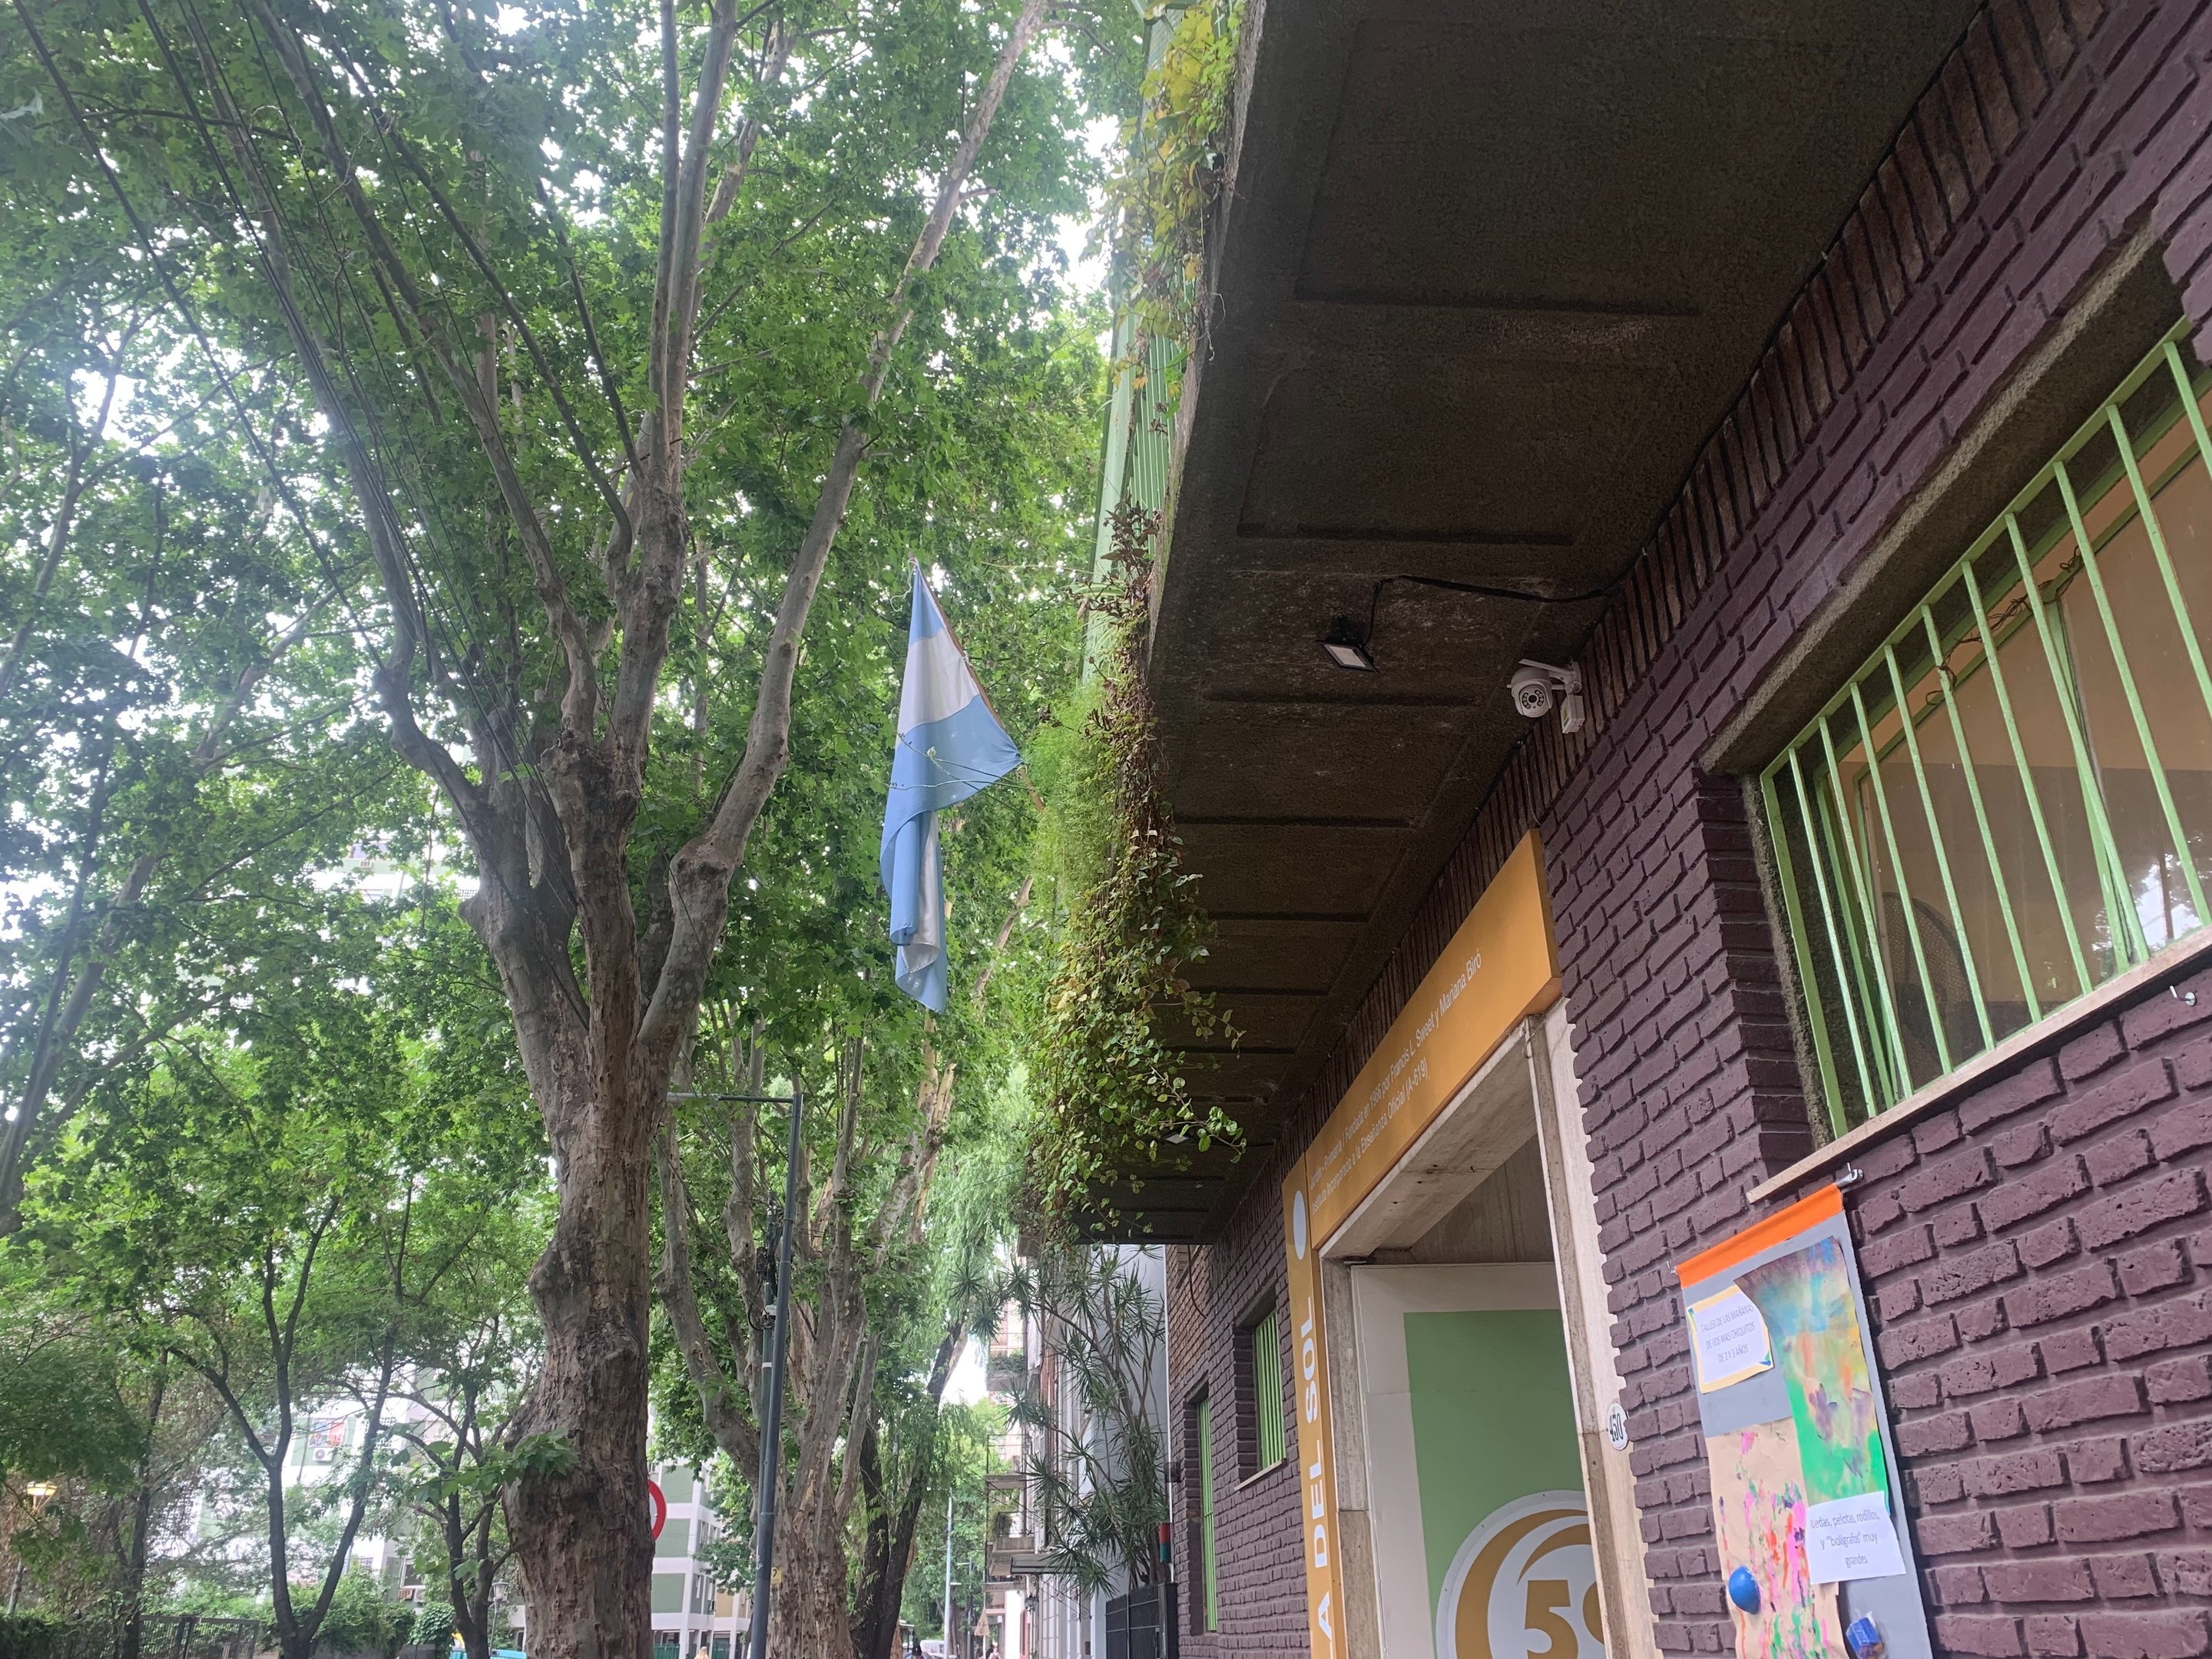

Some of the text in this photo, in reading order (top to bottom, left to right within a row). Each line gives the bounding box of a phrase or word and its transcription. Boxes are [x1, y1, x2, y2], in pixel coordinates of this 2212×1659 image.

[1345, 1109, 1364, 1143] Fundada
[1364, 1102, 1370, 1119] en
[1382, 1072, 1391, 1099] por
[1389, 1047, 1410, 1082] Francis
[1409, 1039, 1416, 1057] L.
[1416, 1012, 1435, 1048] Sweet
[1433, 1008, 1439, 1028] y
[1439, 972, 1466, 1017] Mariana
[1465, 947, 1482, 982] Biró
[1356, 1145, 1361, 1160] la
[1360, 1113, 1388, 1154] Enseñanza
[1387, 1084, 1406, 1120] Oficial
[1406, 1056, 1428, 1101] (A-619)
[1700, 1303, 1754, 1333] TALLER DE LAS MAÑANAS
[1705, 1339, 1713, 1349] DE
[1712, 1336, 1720, 1346] LOS
[1730, 1322, 1756, 1339] CHIQUITOS
[1718, 1353, 1725, 1363] DE
[1724, 1351, 1728, 1360] 2
[1731, 1349, 1736, 1358] 3
[1736, 1343, 1749, 1356] AÑOS
[1300, 1296, 1334, 1659] A DEL SOL
[1832, 1512, 1857, 1528] pelotas,
[1856, 1508, 1881, 1522] rodillos,
[1820, 1539, 1825, 1551] y
[1863, 1532, 1878, 1545] muy
[1845, 1553, 1868, 1568] grandes
